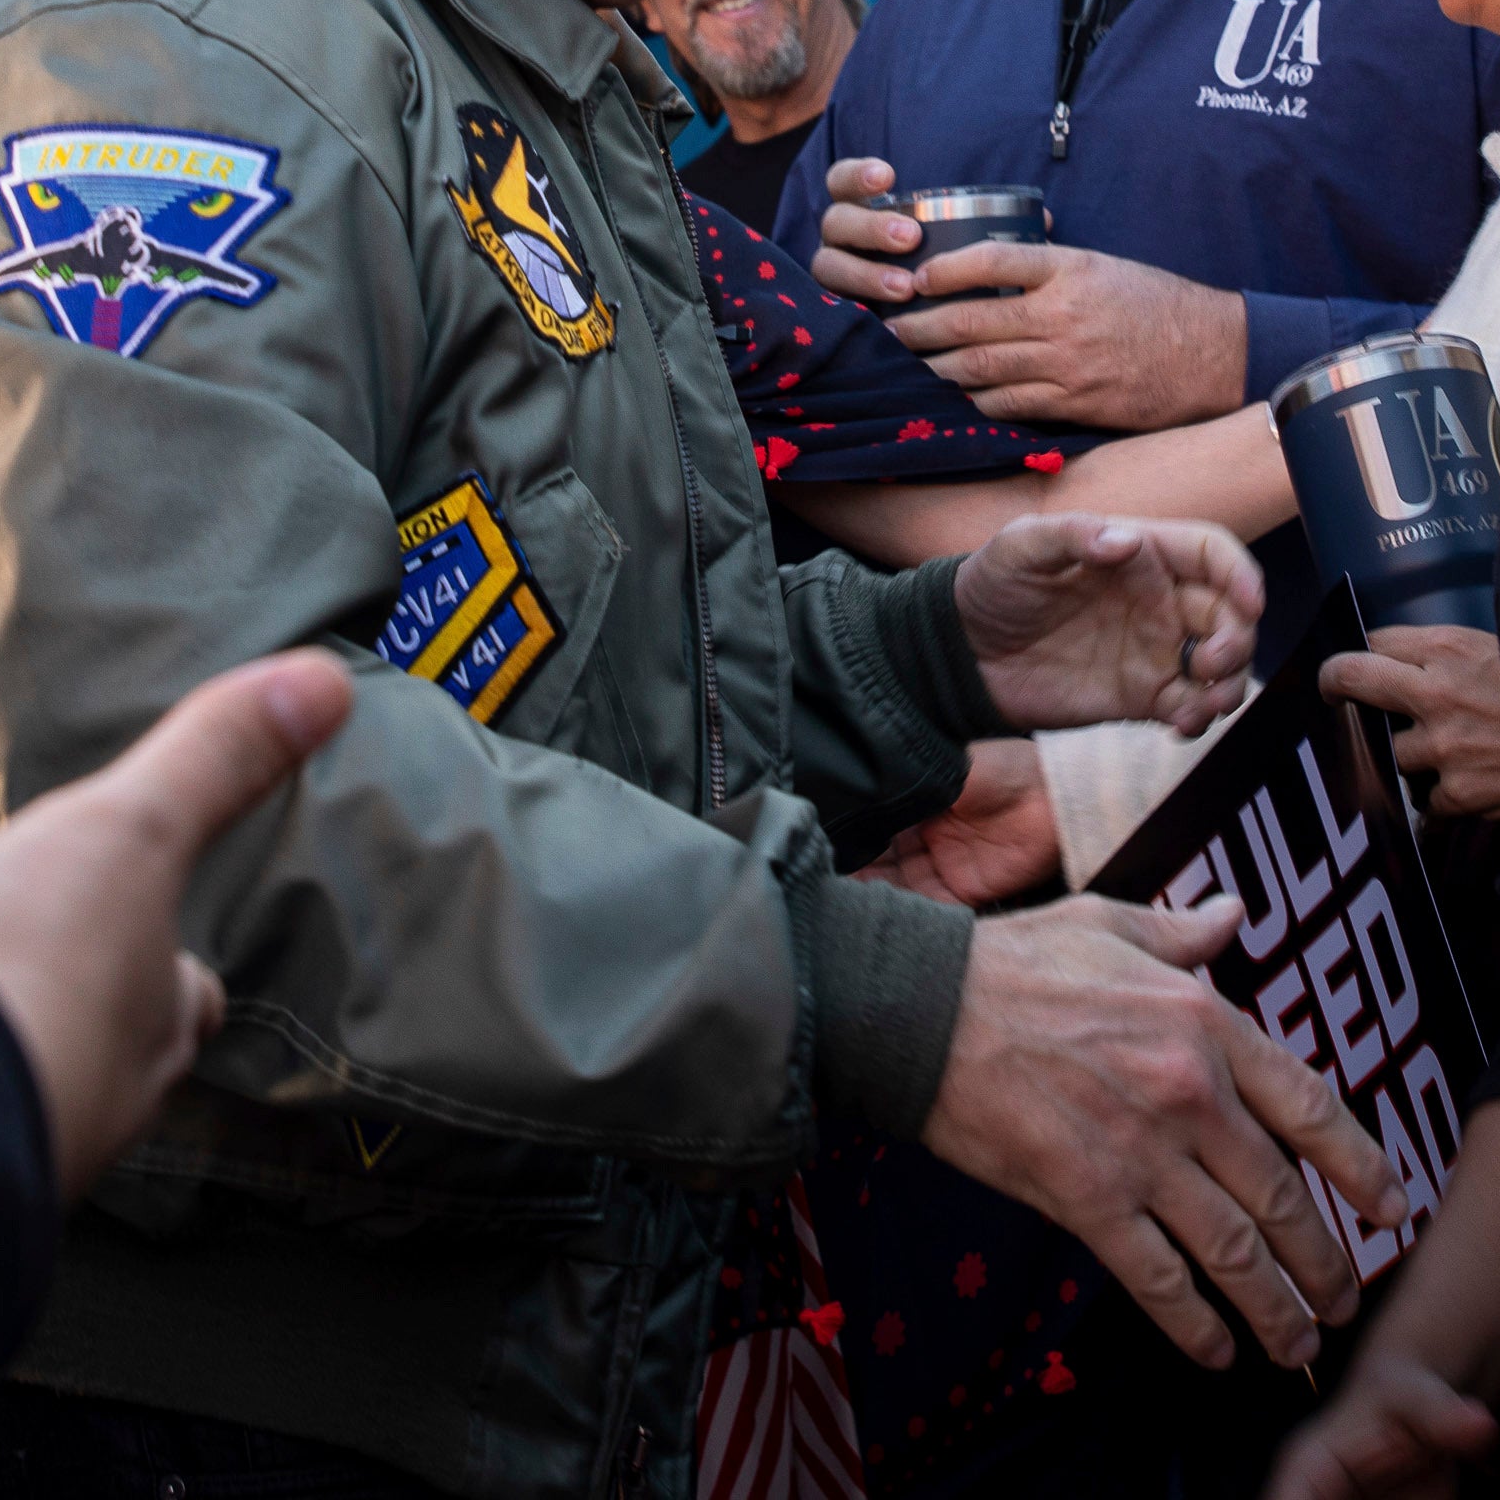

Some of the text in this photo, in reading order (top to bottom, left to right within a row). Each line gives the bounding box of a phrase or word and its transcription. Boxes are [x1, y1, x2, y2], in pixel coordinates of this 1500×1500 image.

[1272, 61, 1314, 88] 469
[1195, 85, 1309, 119] Phoenix, AZ
[35, 141, 240, 184] INTRUDER
[1441, 467, 1490, 498] 469
[399, 506, 452, 550] ION
[1374, 515, 1476, 554] PHOENIX,
[1151, 737, 1370, 990] FULL
[1252, 876, 1420, 1094] EED
